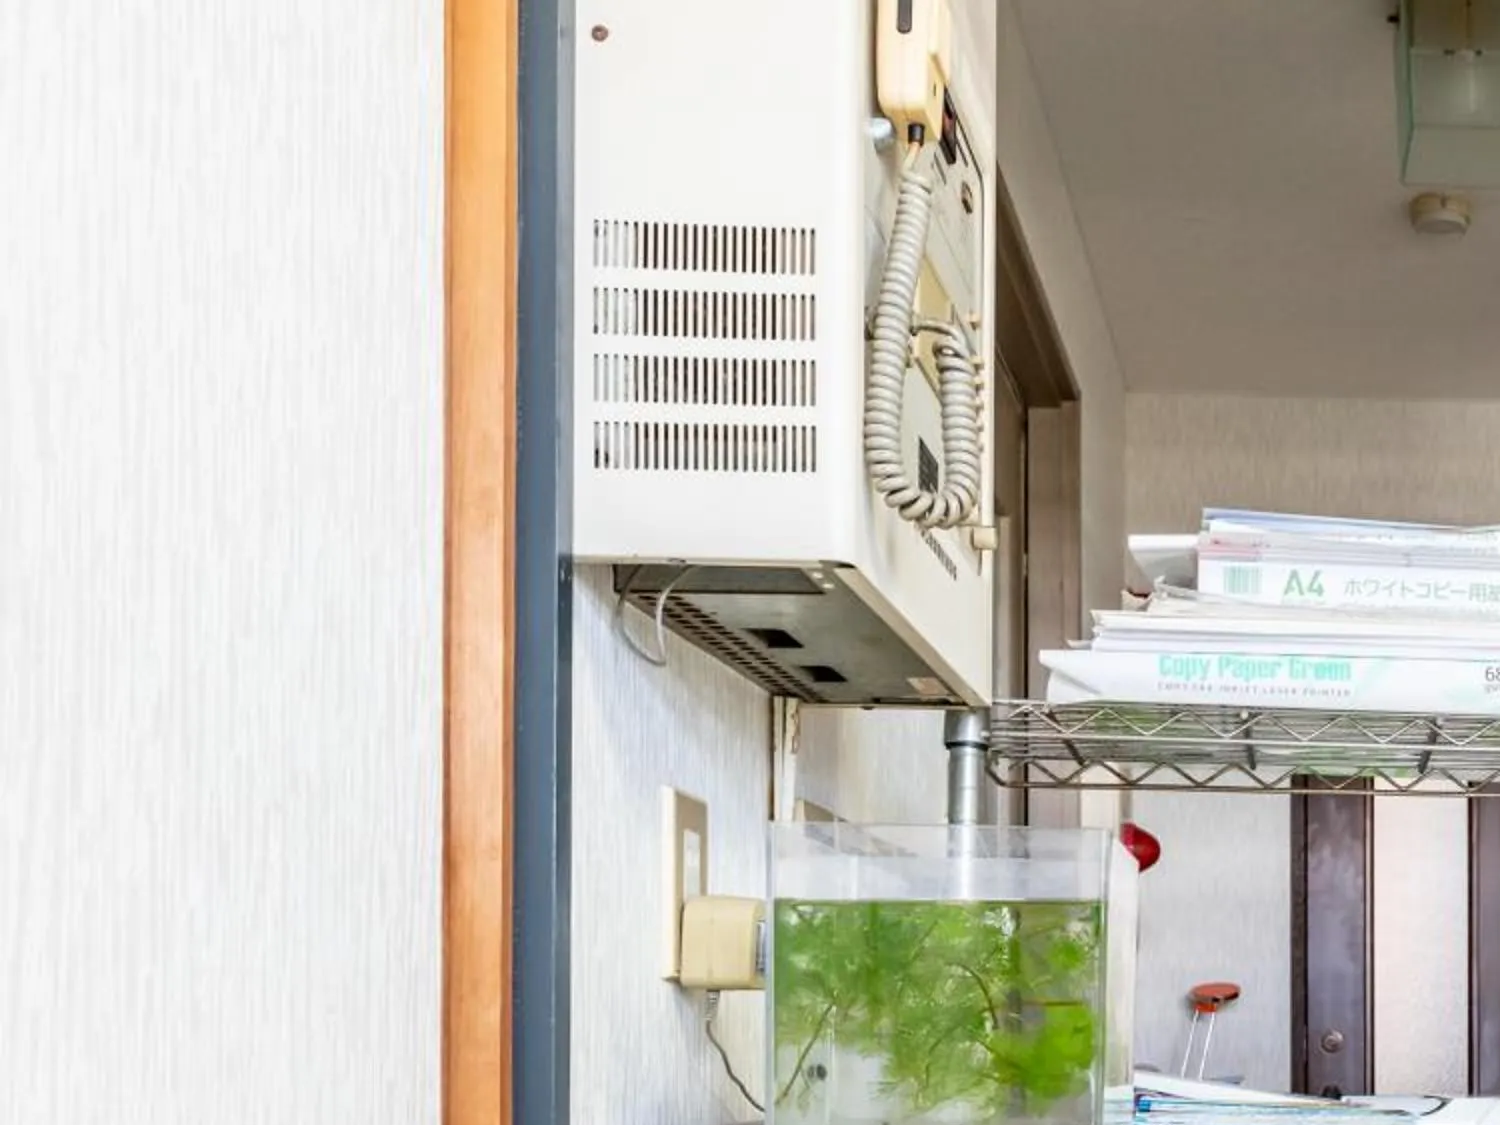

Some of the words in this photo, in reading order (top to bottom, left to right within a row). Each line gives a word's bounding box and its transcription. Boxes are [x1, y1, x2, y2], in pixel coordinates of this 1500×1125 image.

[1284, 568, 1325, 597] A4
[1158, 655, 1211, 681] Copy
[1217, 656, 1281, 682] Paper
